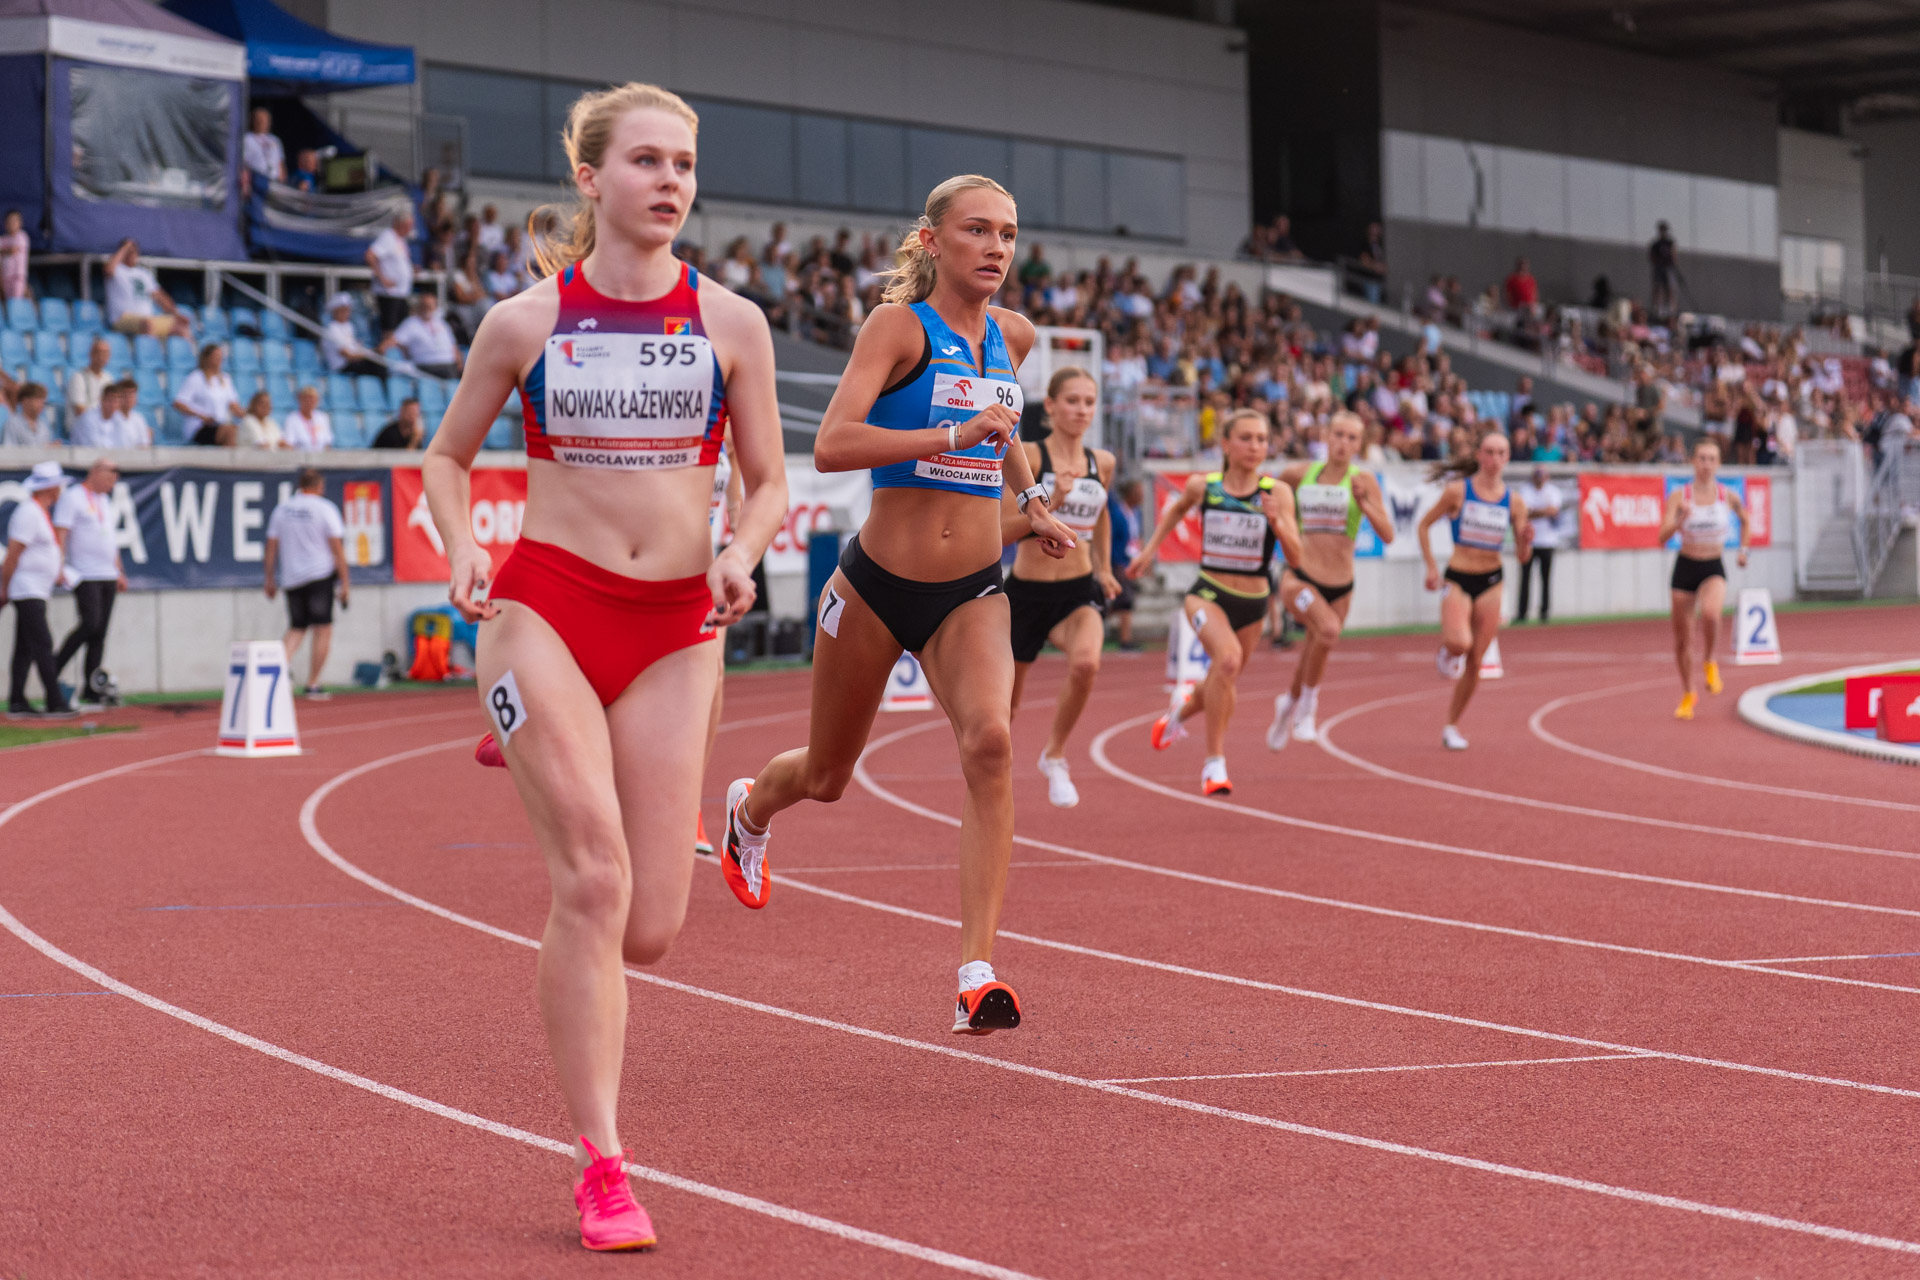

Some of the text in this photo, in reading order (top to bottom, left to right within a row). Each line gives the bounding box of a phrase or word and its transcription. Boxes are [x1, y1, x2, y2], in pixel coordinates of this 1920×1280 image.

[640, 342, 696, 366] 595
[552, 382, 703, 419] NOWAK ŁAŻEWSKA
[947, 386, 1014, 408] ORLEN 96
[575, 437, 596, 447] PZLA
[598, 438, 650, 448] Mistrzostwa
[652, 438, 676, 448] Polski
[564, 451, 687, 466] WŁOCŁAWEK 2025
[941, 456, 956, 465] PZLA
[957, 459, 991, 468] Mistrzostwa
[929, 466, 993, 483] WŁOCŁAWEK
[822, 589, 838, 625] 7
[1748, 606, 1769, 645] 2
[230, 665, 247, 729] 7
[257, 665, 281, 729] 7
[492, 685, 516, 732] 8
